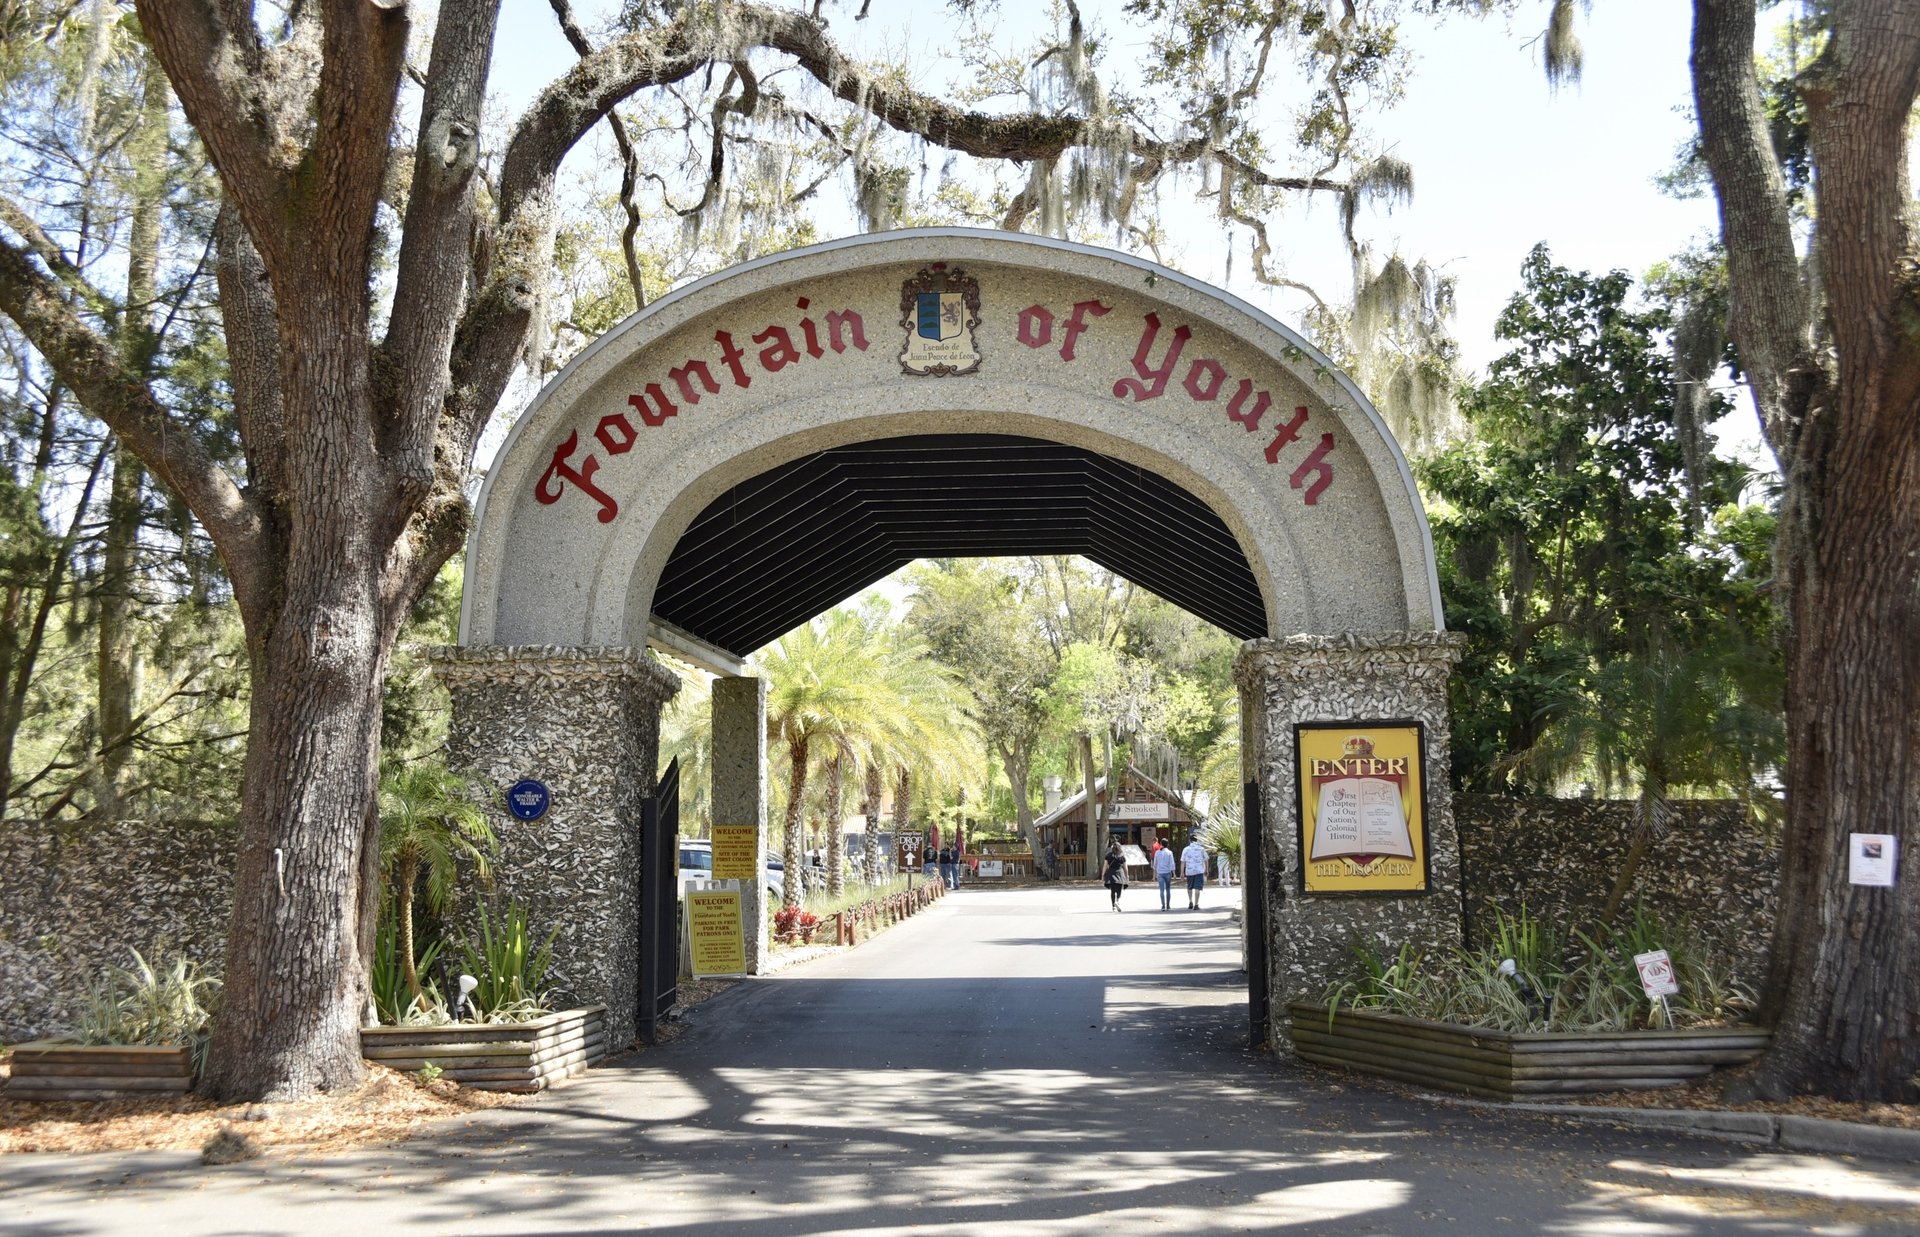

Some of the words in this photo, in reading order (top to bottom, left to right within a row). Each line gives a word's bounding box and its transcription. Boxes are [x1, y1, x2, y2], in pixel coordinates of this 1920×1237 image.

[951, 343, 960, 351] de
[909, 352, 927, 361] Juan
[928, 352, 948, 361] Ponce
[949, 352, 958, 360] de
[535, 296, 870, 524] Fountain
[1016, 300, 1113, 362] of
[1112, 312, 1335, 505] Youth
[1312, 758, 1406, 776] ENTER
[1332, 788, 1357, 801] First
[1326, 800, 1357, 808] Chapter
[1327, 816, 1357, 824] Nation's
[1330, 833, 1357, 841] History
[1315, 863, 1340, 877] THE
[1344, 863, 1412, 877] DISCOVERY
[694, 898, 735, 906] WELCOME
